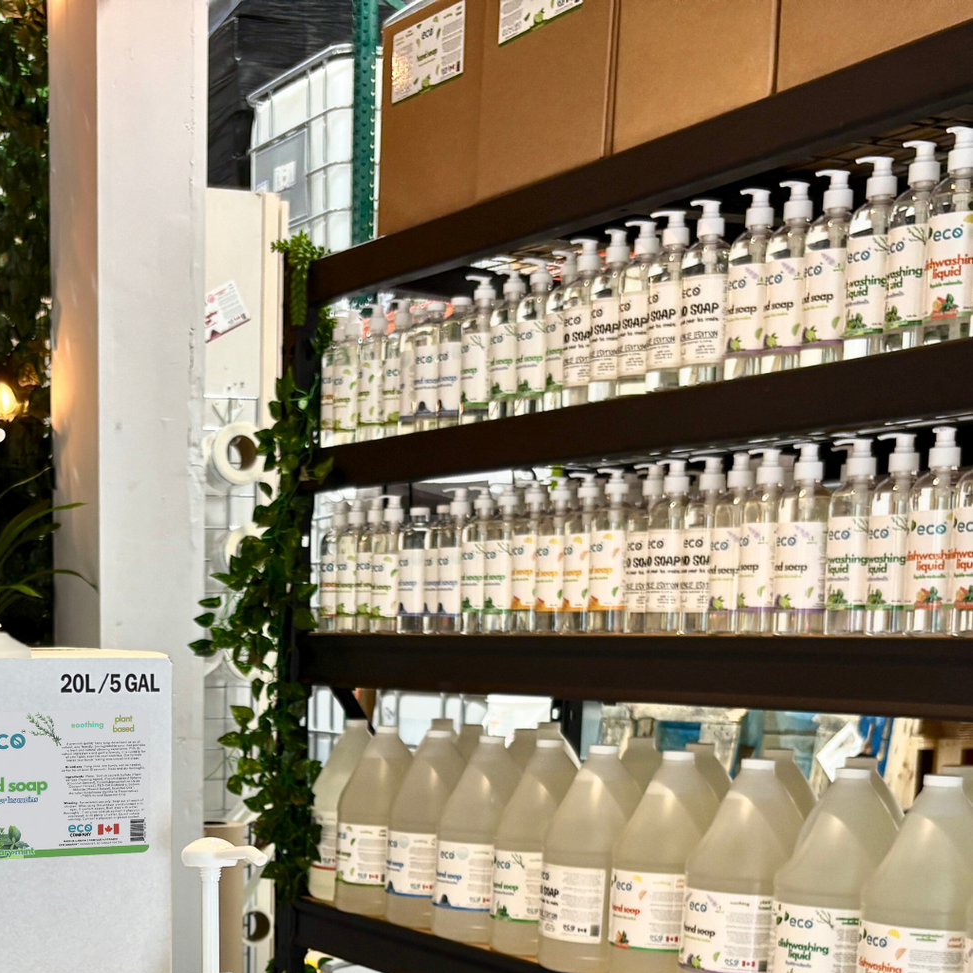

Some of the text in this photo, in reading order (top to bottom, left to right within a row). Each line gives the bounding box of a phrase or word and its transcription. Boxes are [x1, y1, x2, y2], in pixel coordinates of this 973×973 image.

[933, 226, 963, 242] eco
[847, 249, 870, 263] eco
[932, 265, 962, 281] liquid
[810, 293, 834, 304] soap
[690, 302, 719, 315] SOAP
[735, 305, 757, 315] soap
[771, 301, 794, 311] soap
[651, 308, 676, 322] SOAP
[594, 320, 619, 336] SOAP
[623, 316, 647, 330] SOAP
[828, 529, 850, 541] eco
[917, 523, 947, 536] eco
[684, 538, 703, 548] eco
[654, 555, 680, 567] SOAP
[916, 560, 945, 573] liquid
[784, 563, 808, 573] soap
[125, 673, 161, 693] GAL
[70, 720, 104, 730] soothing
[114, 715, 133, 725] plant
[112, 724, 135, 733] based
[7, 779, 48, 797] soap
[67, 822, 93, 834] eco
[616, 881, 632, 892] eco
[689, 901, 707, 912] eco
[789, 917, 813, 929] eco
[778, 938, 830, 955] dishwashing
[867, 935, 888, 948] eco
[787, 949, 811, 961] liquid
